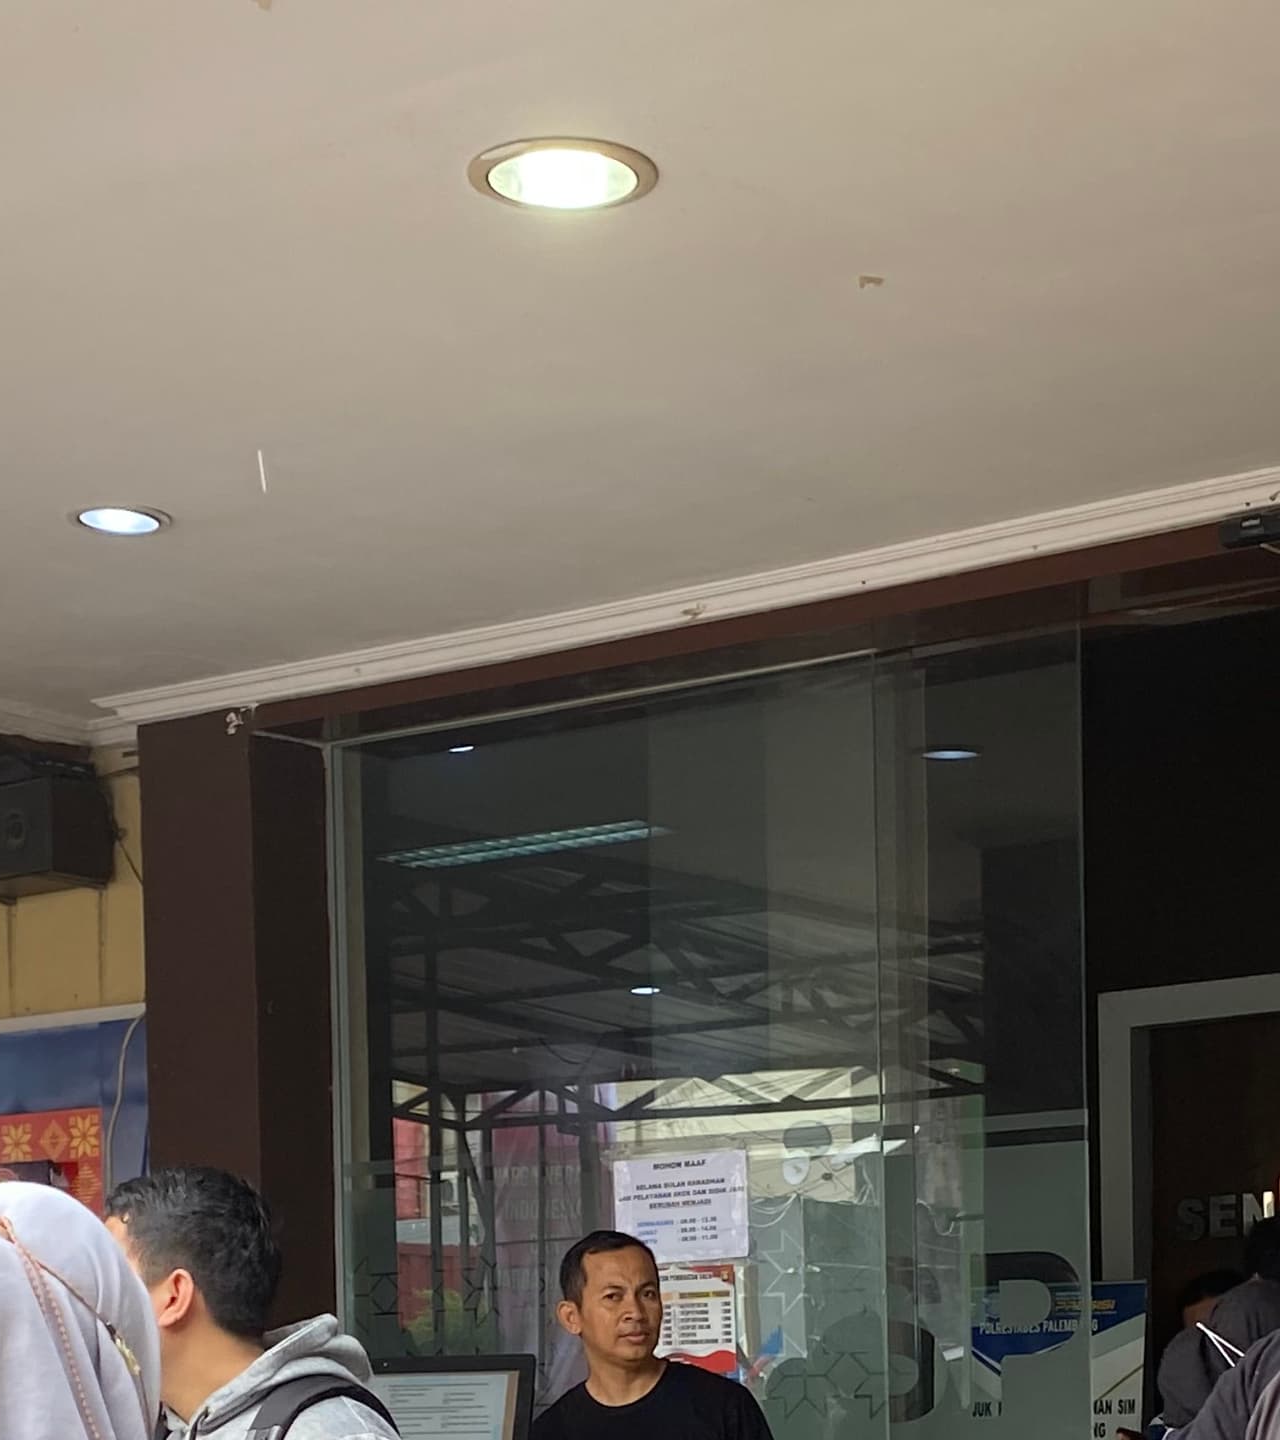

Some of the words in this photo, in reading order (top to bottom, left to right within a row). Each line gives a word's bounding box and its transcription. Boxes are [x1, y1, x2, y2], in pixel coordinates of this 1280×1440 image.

[653, 1161, 682, 1170] MOHON
[684, 1159, 706, 1168] MAAF
[1117, 1399, 1136, 1415] SIM
